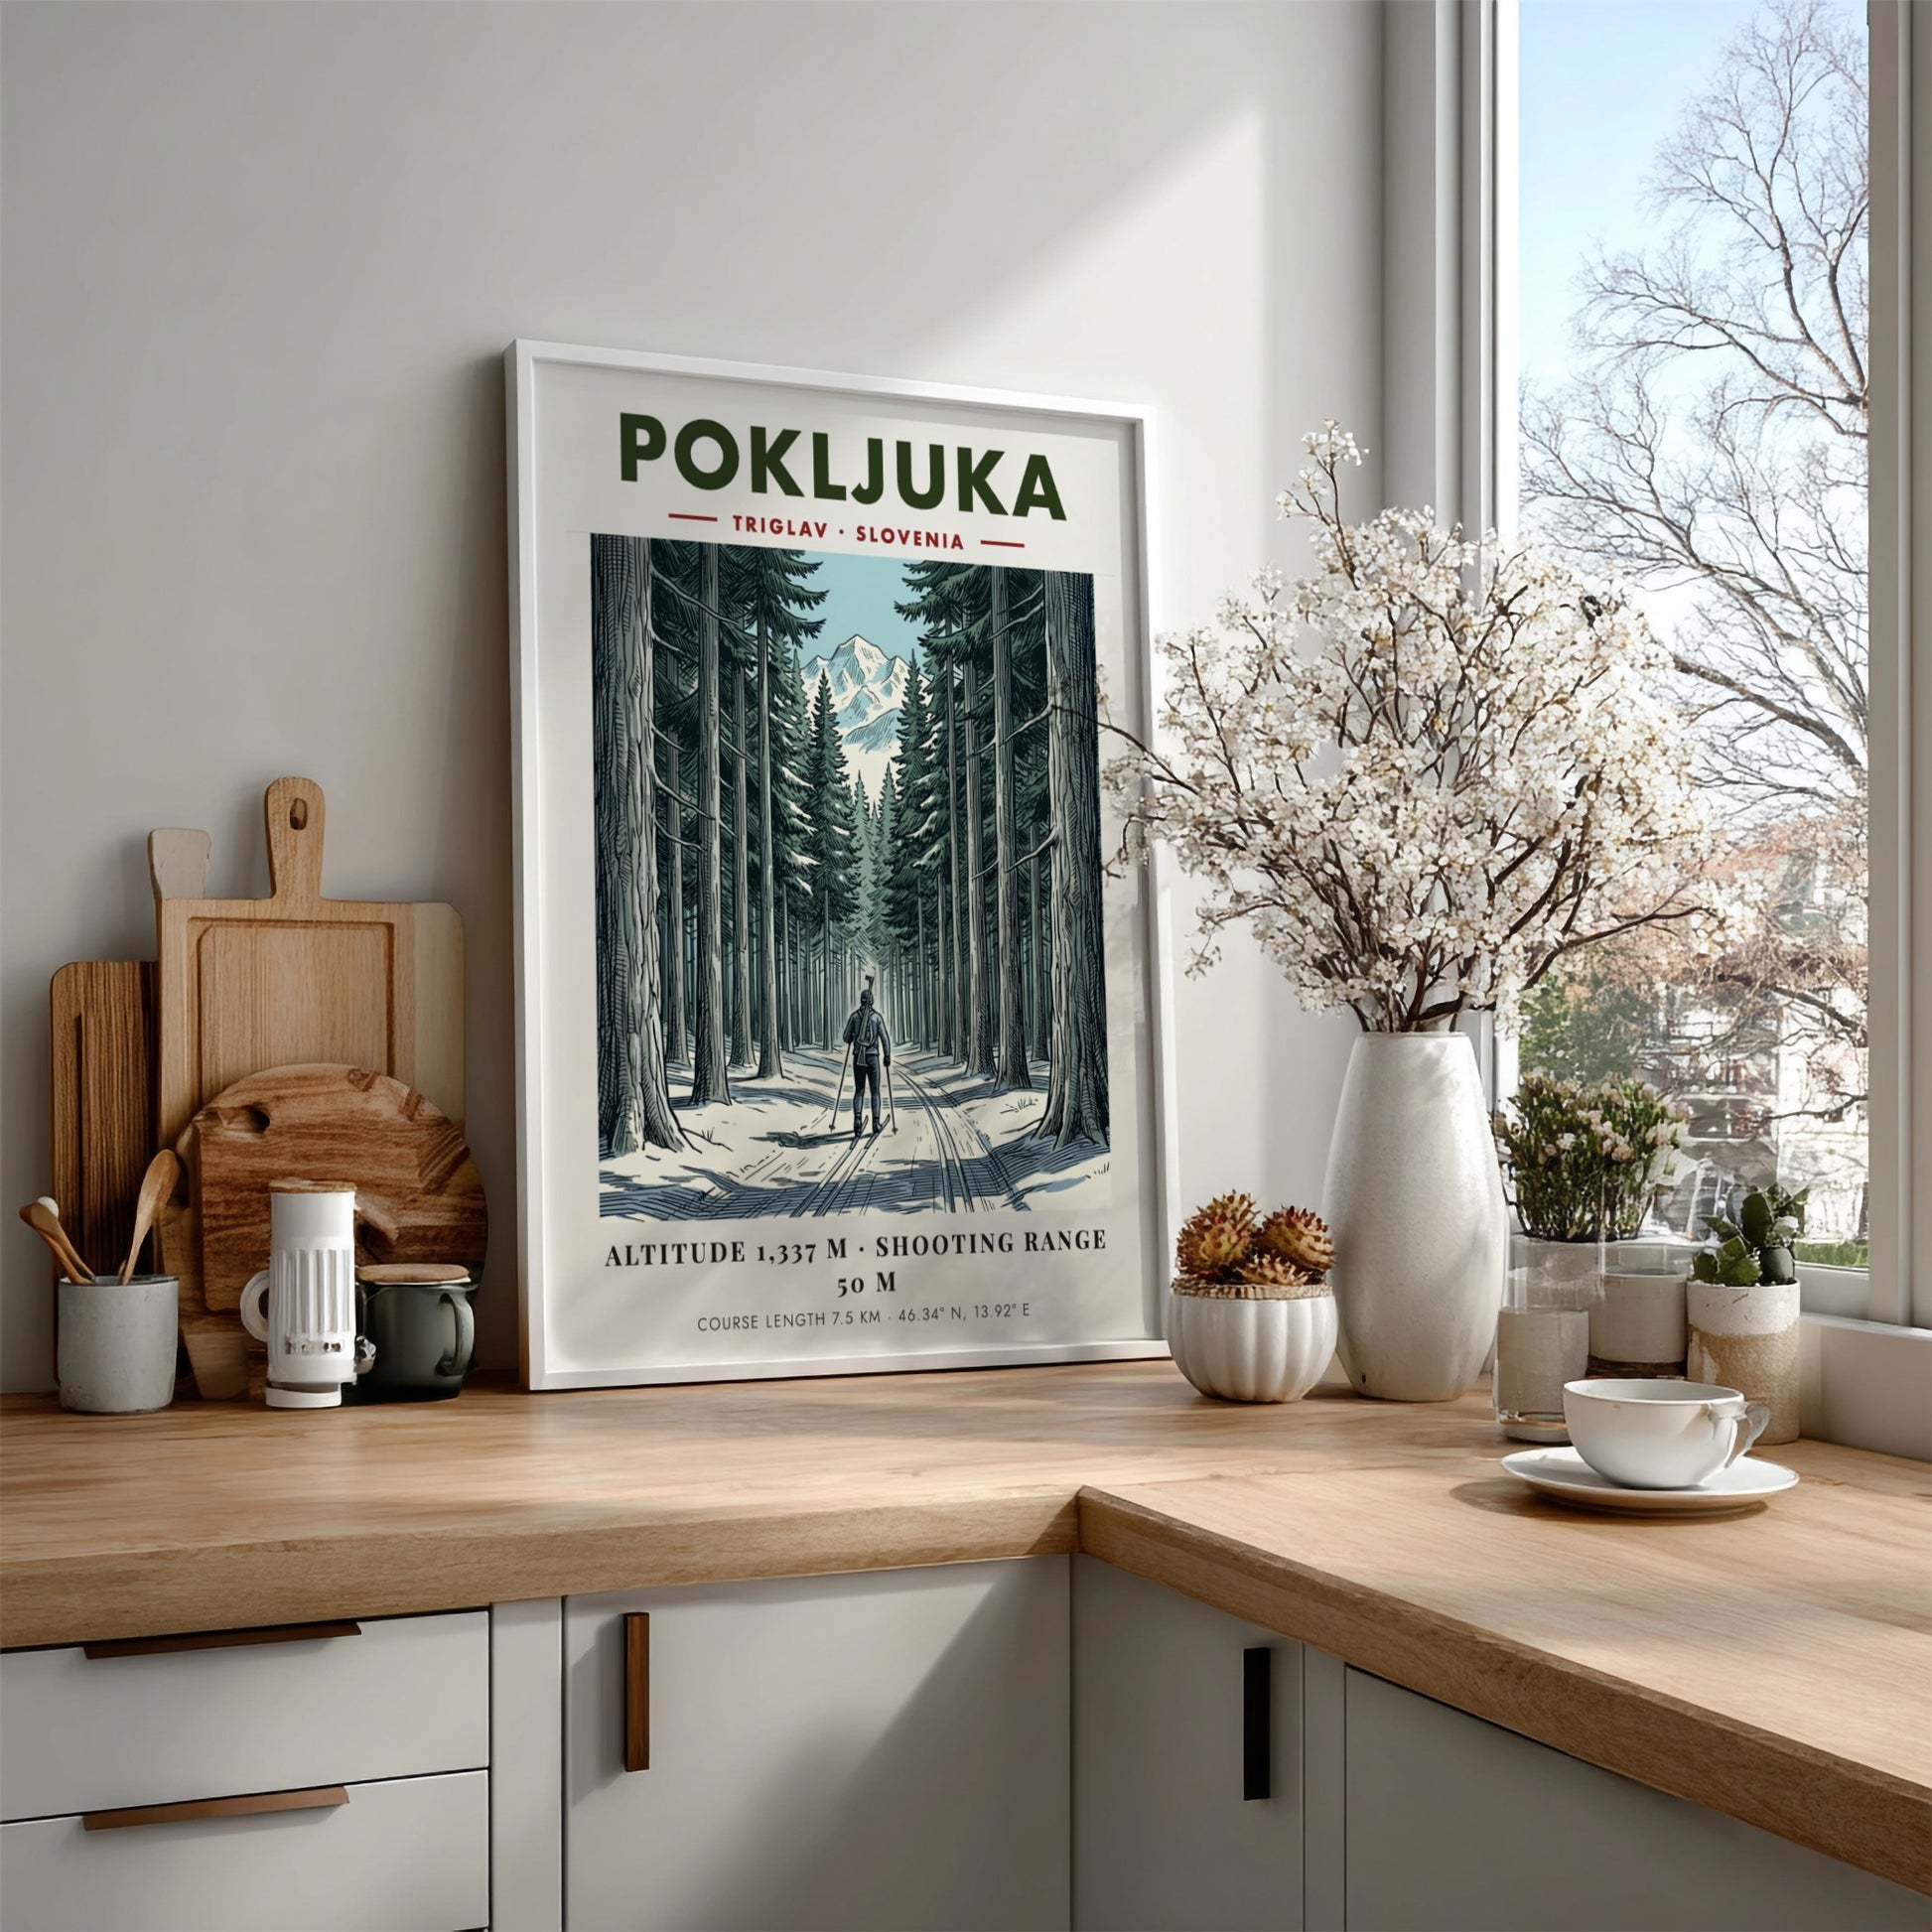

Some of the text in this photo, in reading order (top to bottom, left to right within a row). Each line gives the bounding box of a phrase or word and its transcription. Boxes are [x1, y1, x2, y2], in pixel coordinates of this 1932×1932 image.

[621, 412, 1067, 521] POKLJUKA
[733, 514, 965, 550] TRIGLAV SLOVENIA
[605, 1229, 1107, 1268] ALTITUDE 1,337 M SHOOTING RANGE
[837, 1271, 897, 1298] 50 M
[697, 1303, 1031, 1332] COURSE LENGTH 7.5 KM 46.34° N, 13.92° E
